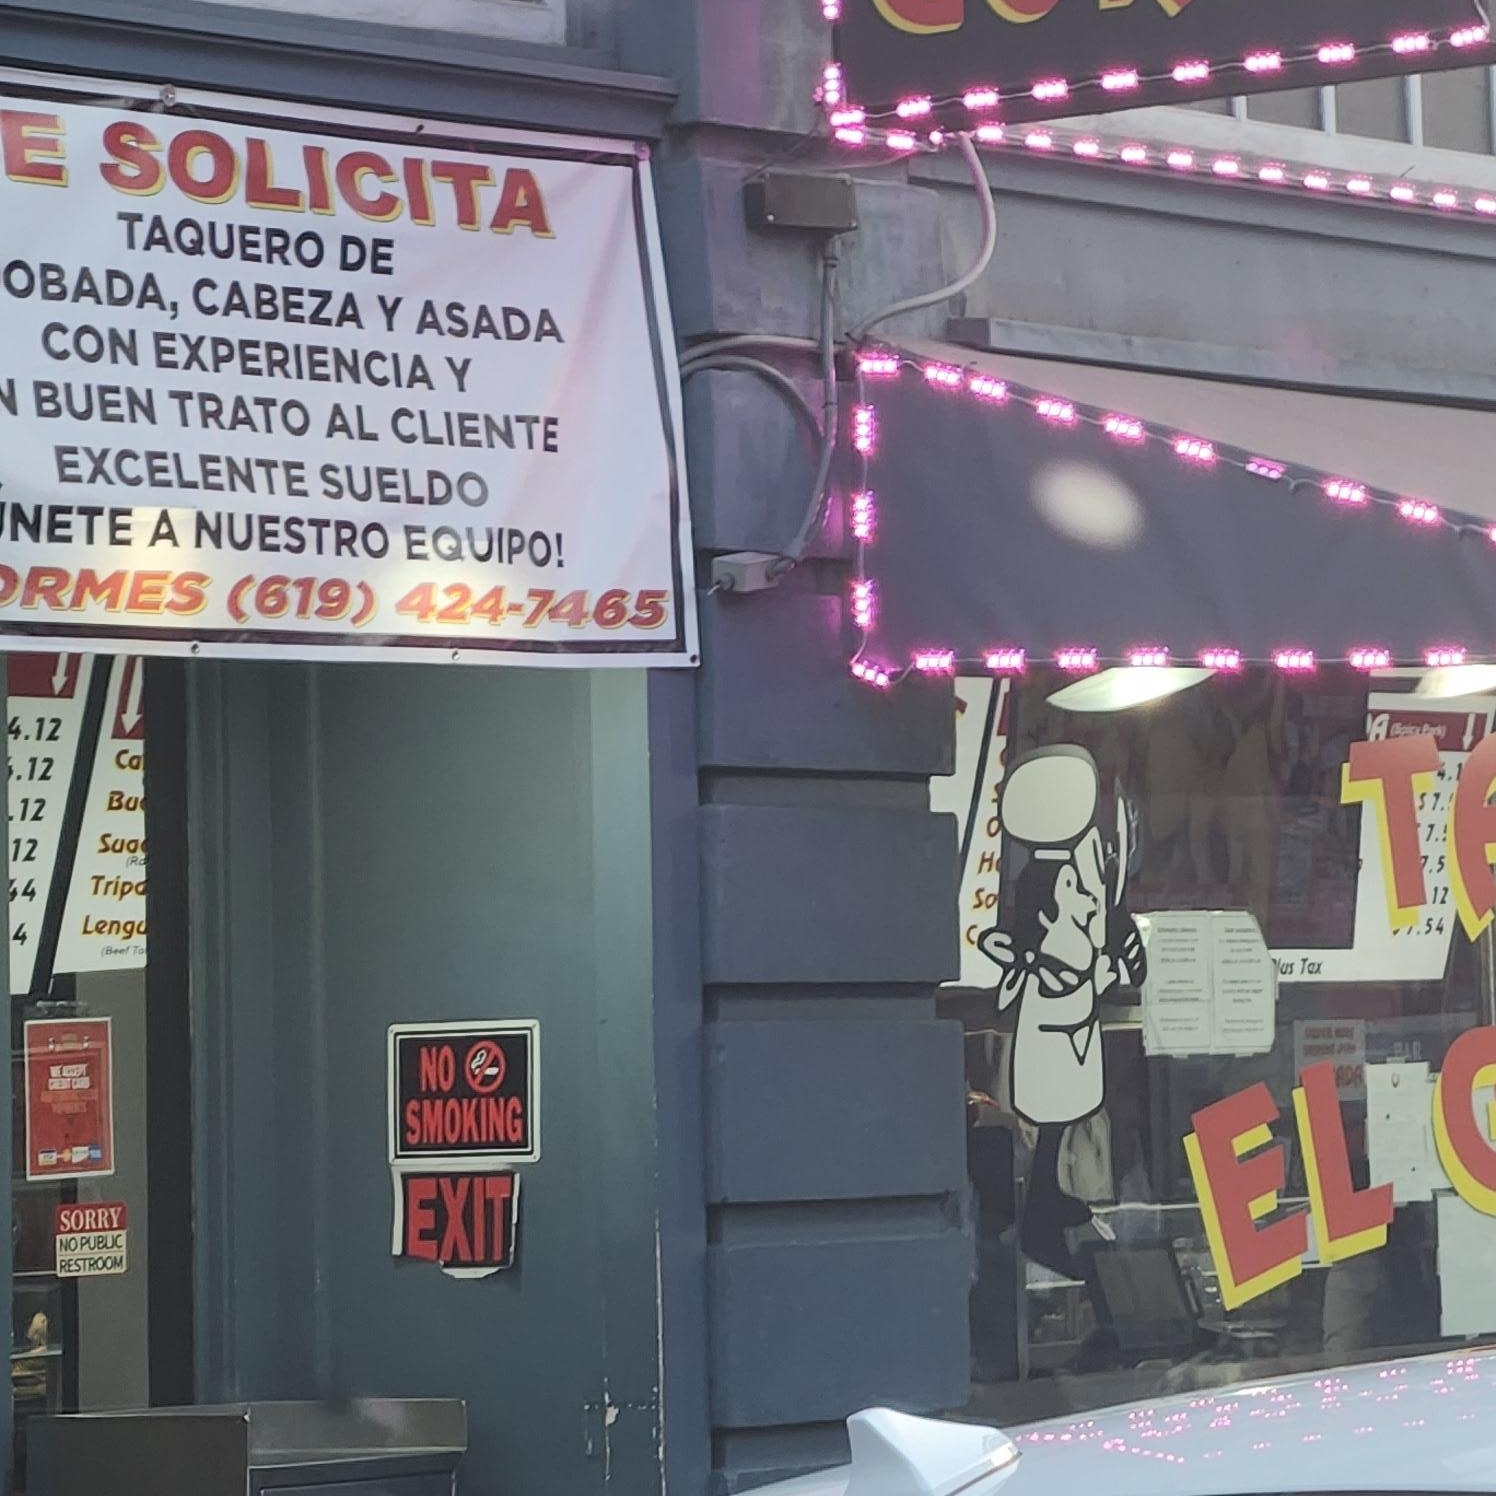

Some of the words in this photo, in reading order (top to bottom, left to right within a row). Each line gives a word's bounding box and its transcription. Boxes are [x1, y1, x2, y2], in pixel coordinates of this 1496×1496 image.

[0, 109, 68, 187] E
[100, 121, 556, 239] SOLICITA
[117, 211, 324, 268] TAQUERO
[340, 235, 395, 275] DE
[3, 259, 178, 320] OBADA,
[192, 278, 364, 329] CABEZA
[377, 295, 403, 331] Y
[416, 300, 565, 343] ASADA
[41, 322, 138, 365] CON
[152, 331, 435, 390] EXPERIENCIA
[445, 356, 472, 392] Y
[33, 380, 157, 425] BUEN
[169, 390, 310, 436] TRATO
[326, 403, 378, 442] AL
[391, 407, 559, 453] CLIENTE
[54, 445, 310, 497] EXCELENTE
[320, 463, 488, 507] SUELDO
[147, 509, 180, 547] A
[195, 511, 389, 557] NUESTRO
[403, 524, 564, 568] EQUIPO!
[227, 574, 378, 628] (619)
[395, 581, 668, 630] 424-7465
[115, 749, 145, 771] Ca
[419, 1045, 455, 1092] NO
[405, 1096, 523, 1145] SMOKING
[1183, 1060, 1393, 1311] EL
[60, 1207, 122, 1232] SORRY
[60, 1237, 78, 1252] NO
[80, 1234, 123, 1251] PUBLIC
[408, 1176, 512, 1262] EXIT
[60, 1255, 123, 1273] RESTROOM
